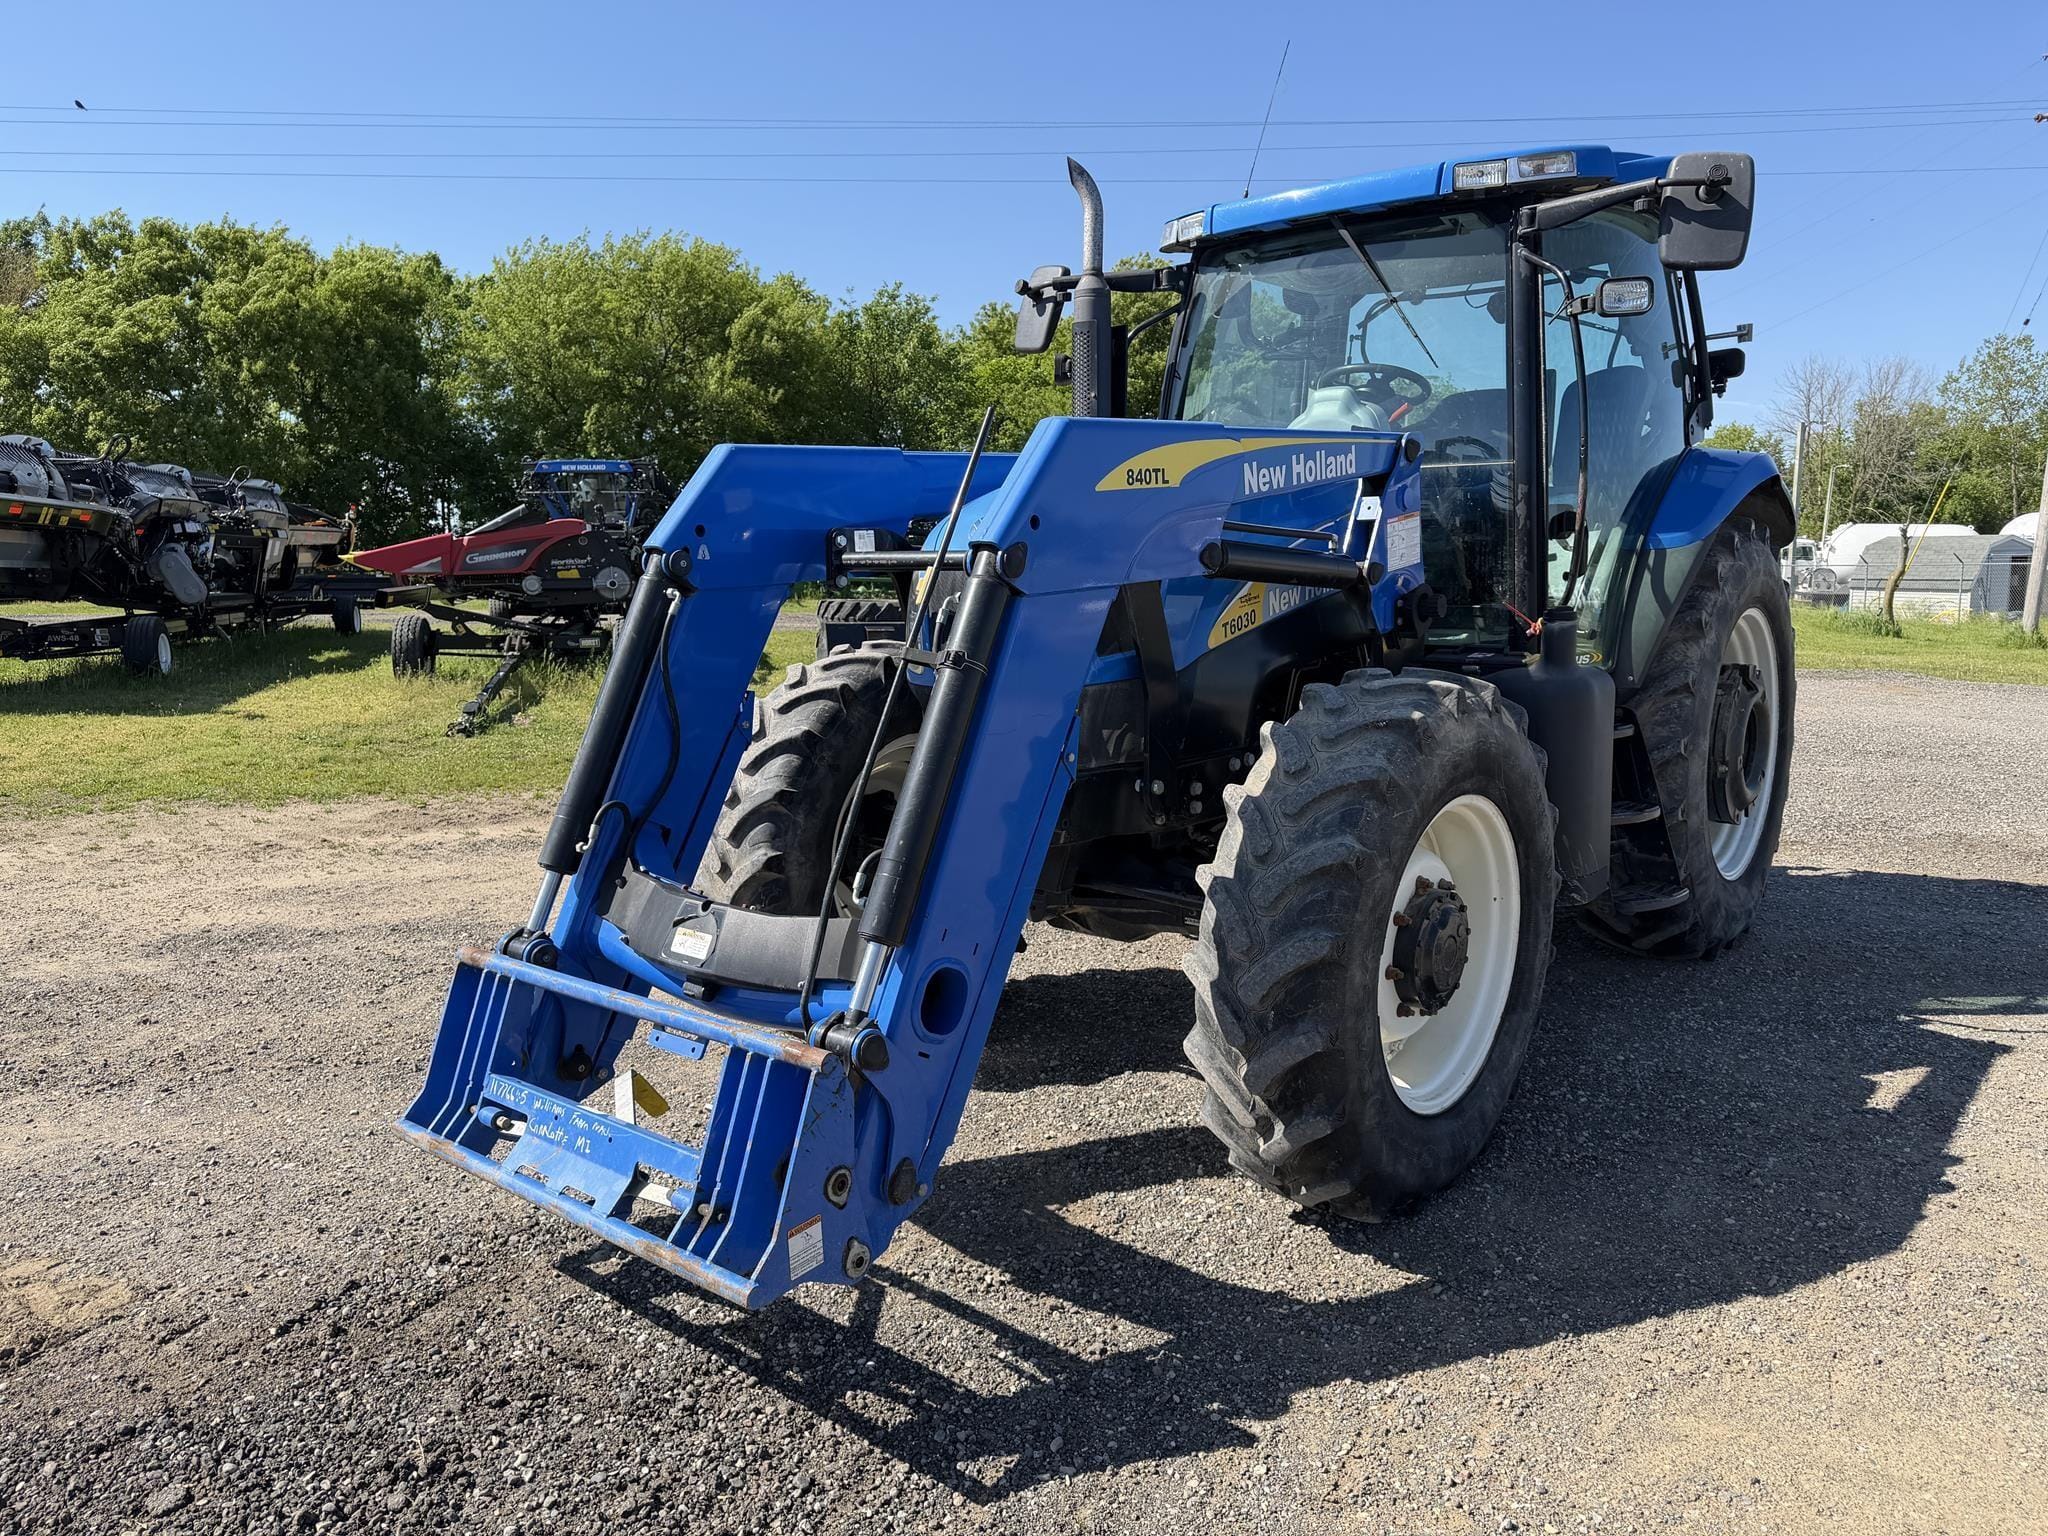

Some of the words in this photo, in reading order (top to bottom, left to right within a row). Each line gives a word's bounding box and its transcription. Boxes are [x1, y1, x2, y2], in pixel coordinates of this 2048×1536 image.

[1126, 468, 1169, 486] 840TL
[1243, 461, 1286, 495] New
[1292, 445, 1356, 485] Holland
[1268, 585, 1301, 617] New
[1222, 609, 1256, 638] T6030
